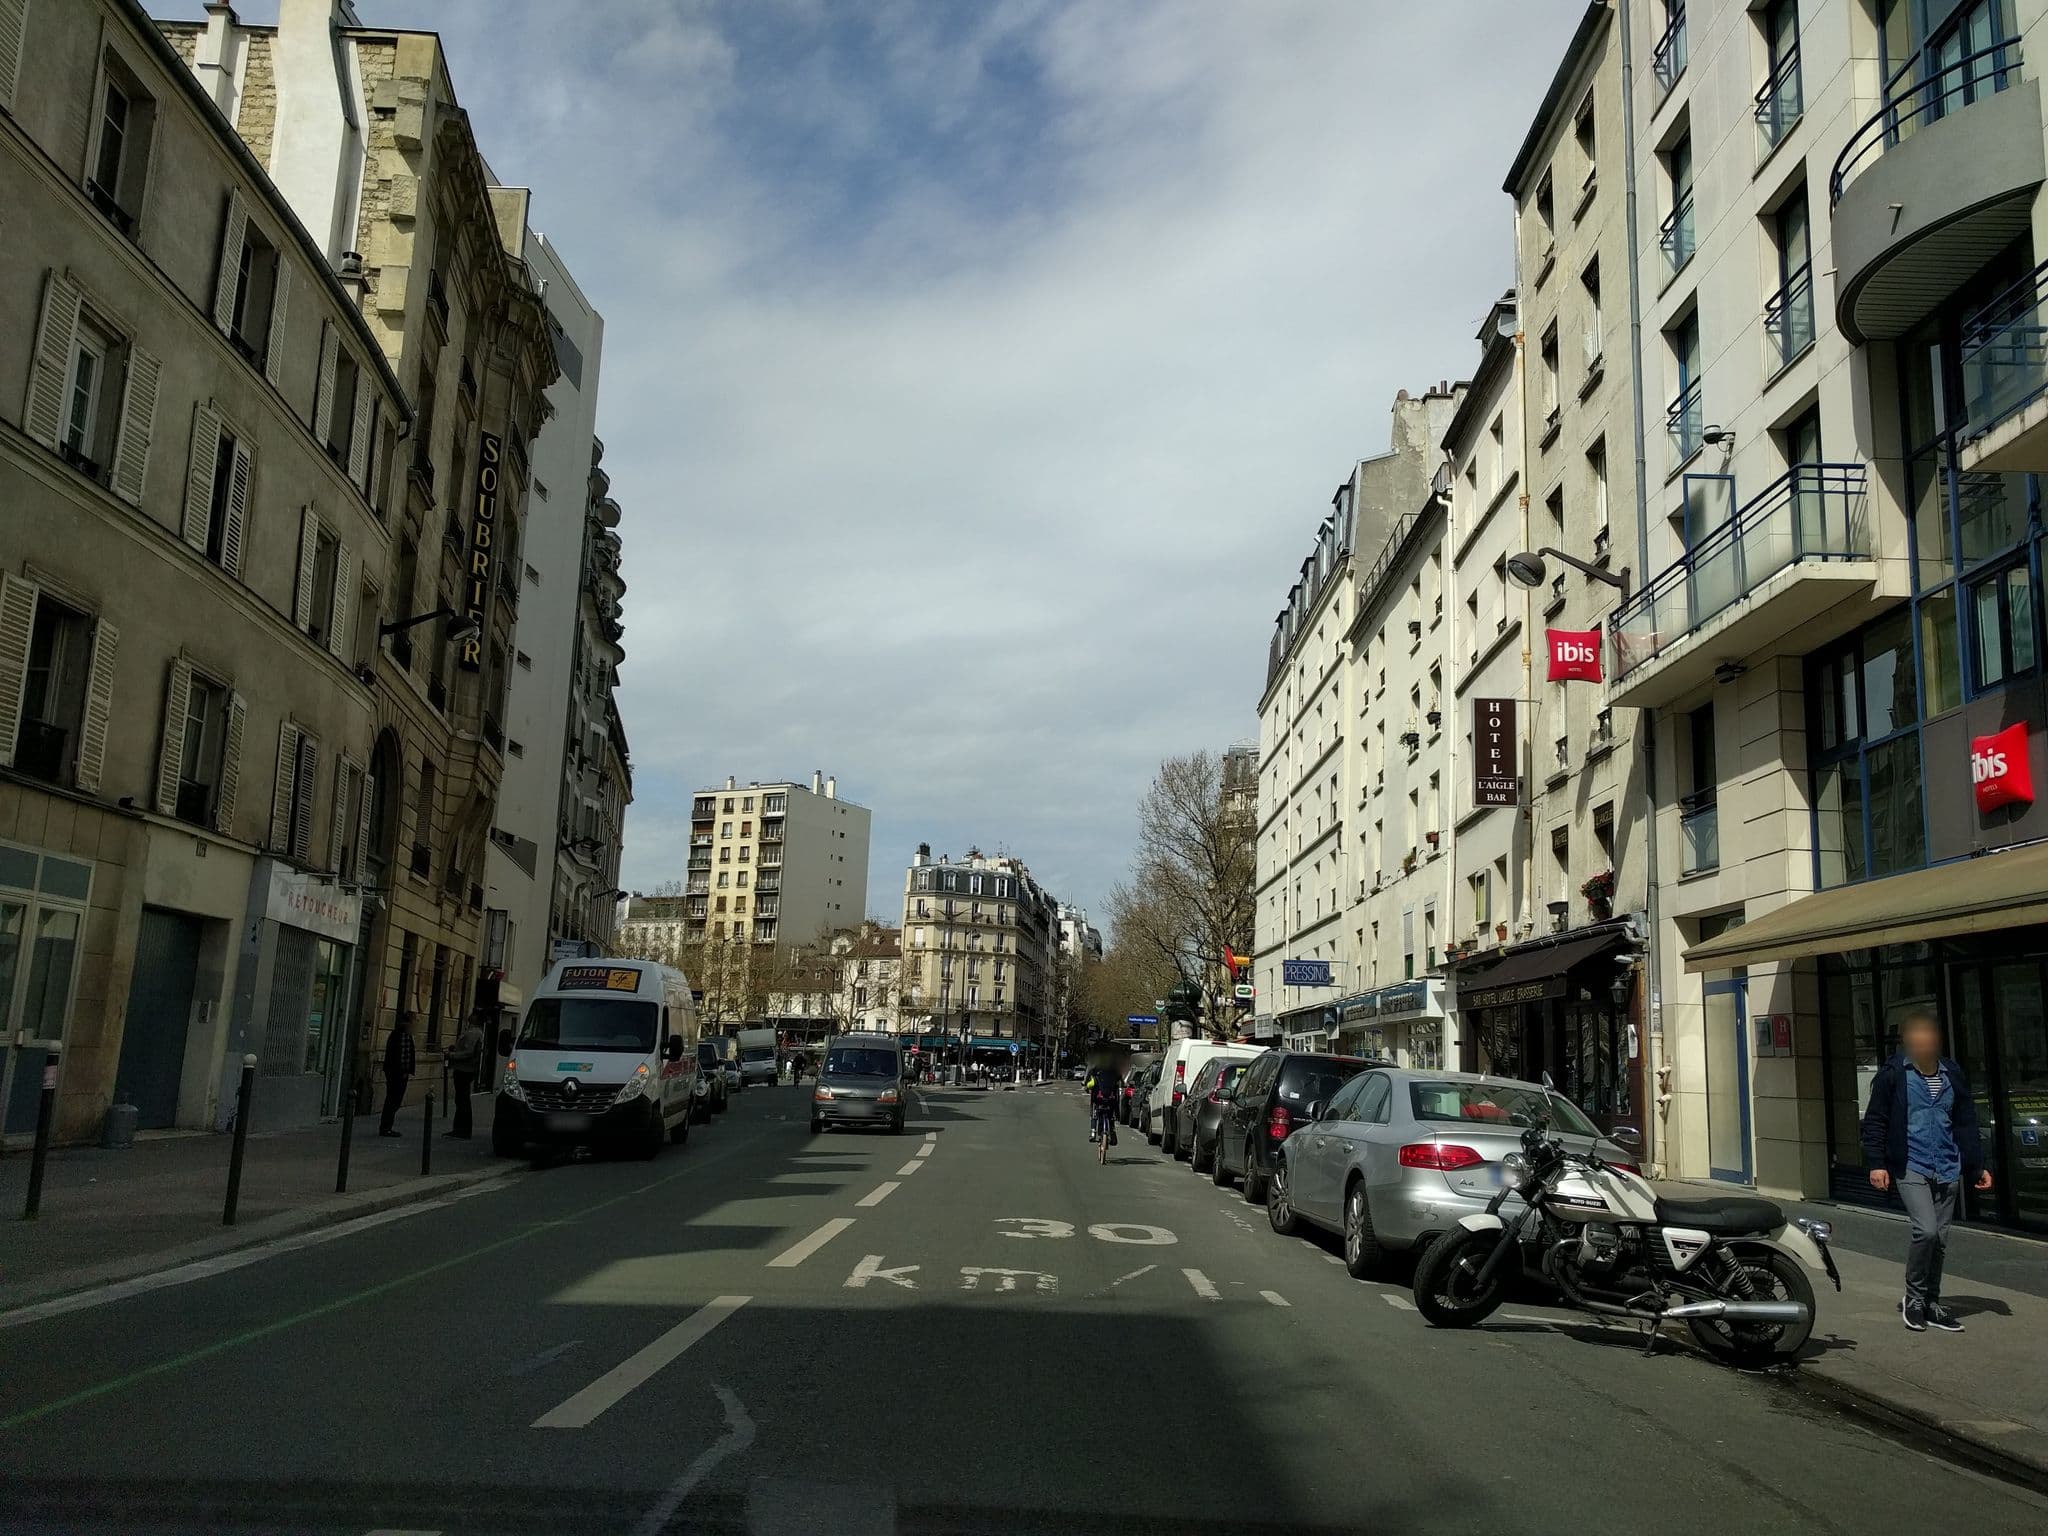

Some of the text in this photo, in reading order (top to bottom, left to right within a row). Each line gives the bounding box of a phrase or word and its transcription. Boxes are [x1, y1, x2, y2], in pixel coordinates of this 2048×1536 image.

[1557, 642, 1595, 663] ibis
[1489, 702, 1502, 774] HOTEL
[1971, 747, 2008, 784] ibis
[1478, 781, 1515, 790] L'AIGLE
[1486, 793, 1507, 801] BAR
[287, 891, 349, 922] RETOUCHEUR
[565, 968, 606, 977] FUTON
[1285, 965, 1329, 981] PRESSING
[1459, 1178, 1475, 1187] A4
[993, 1217, 1178, 1245] 30
